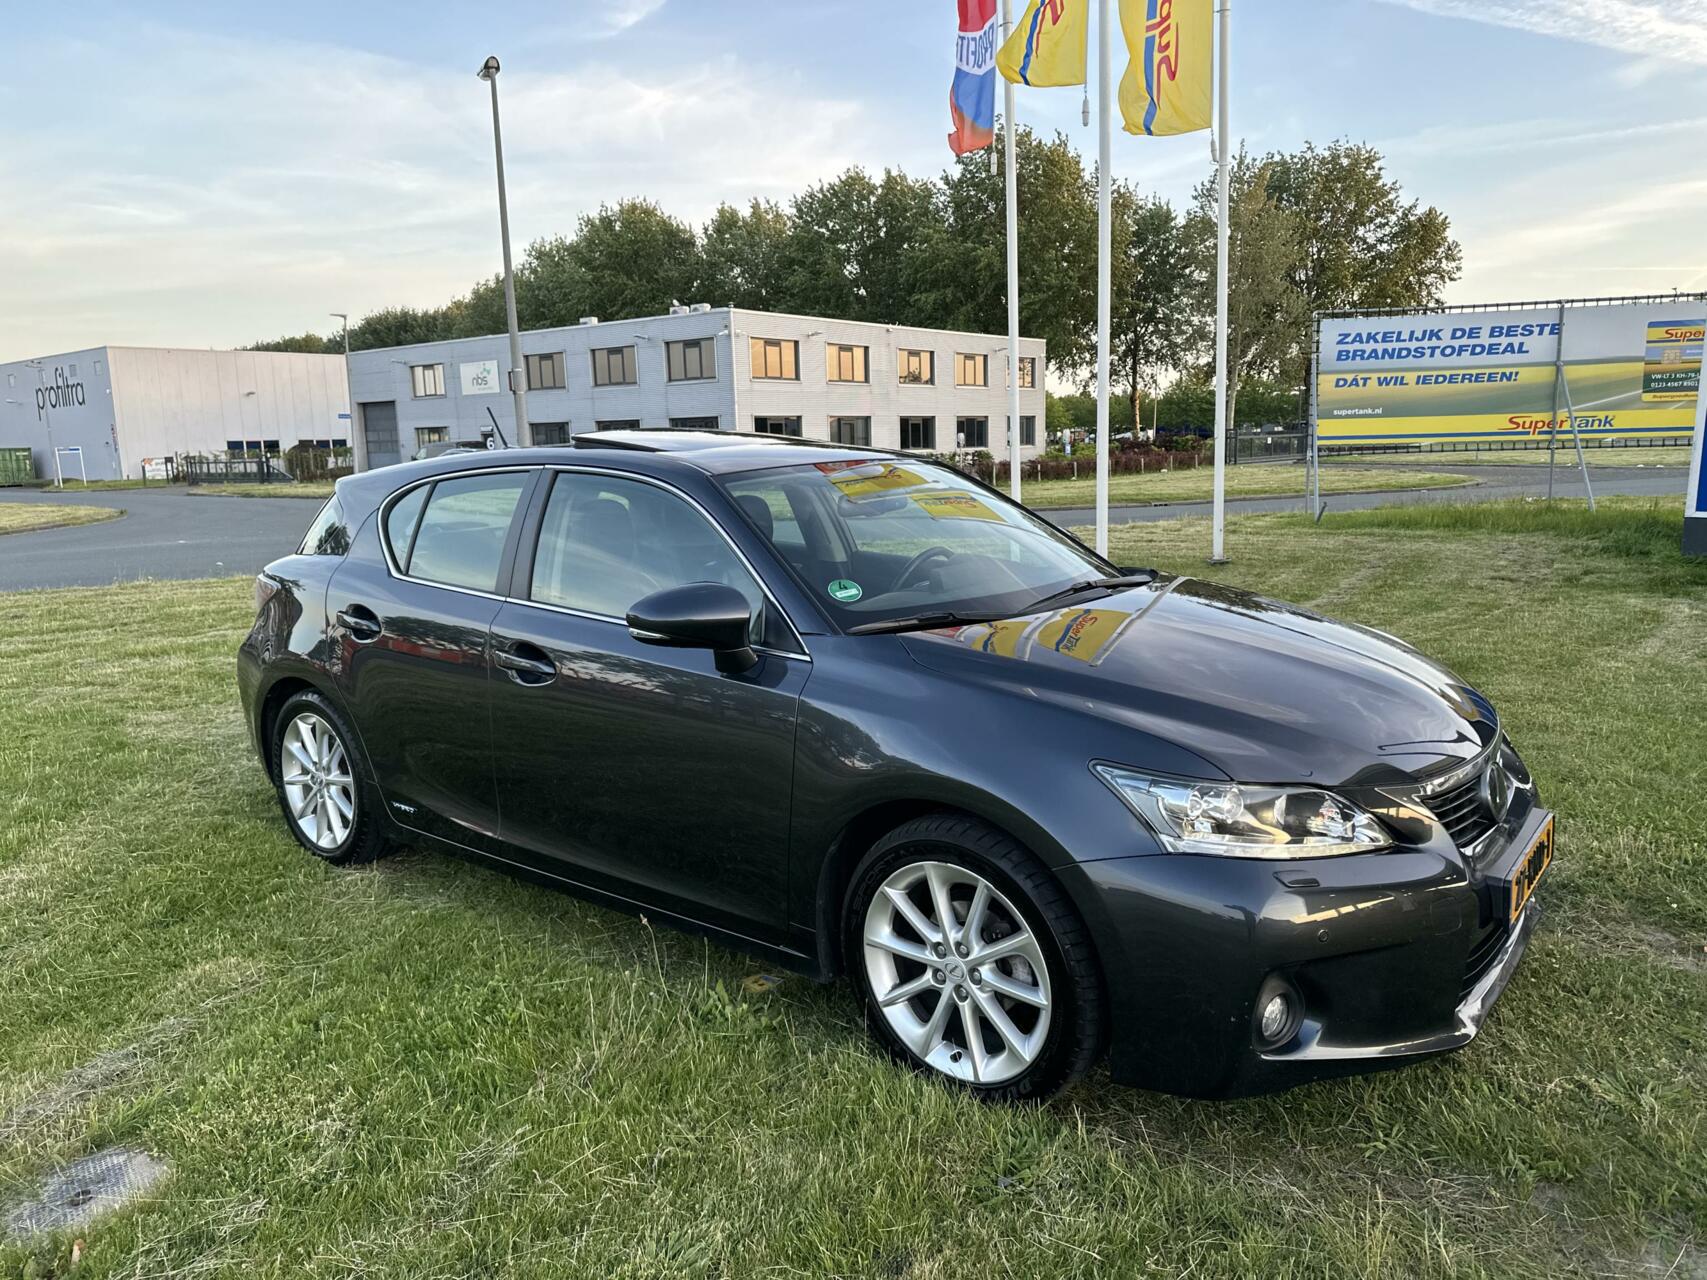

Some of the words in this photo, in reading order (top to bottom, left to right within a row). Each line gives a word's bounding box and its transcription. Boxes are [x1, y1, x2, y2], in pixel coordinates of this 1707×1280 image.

[1336, 329, 1444, 345] ZAKELIJK
[1450, 326, 1482, 340] DE
[1489, 323, 1561, 338] BESTE
[1336, 342, 1529, 361] BRANDSTOFDEAL
[472, 373, 488, 386] nbs
[1334, 374, 1371, 388] DÁT
[1377, 375, 1408, 387] WIL
[1415, 371, 1520, 386] IEDEREEN!
[35, 366, 86, 421] profiltra
[1333, 408, 1383, 416] supertank.nl
[486, 437, 495, 450] 6
